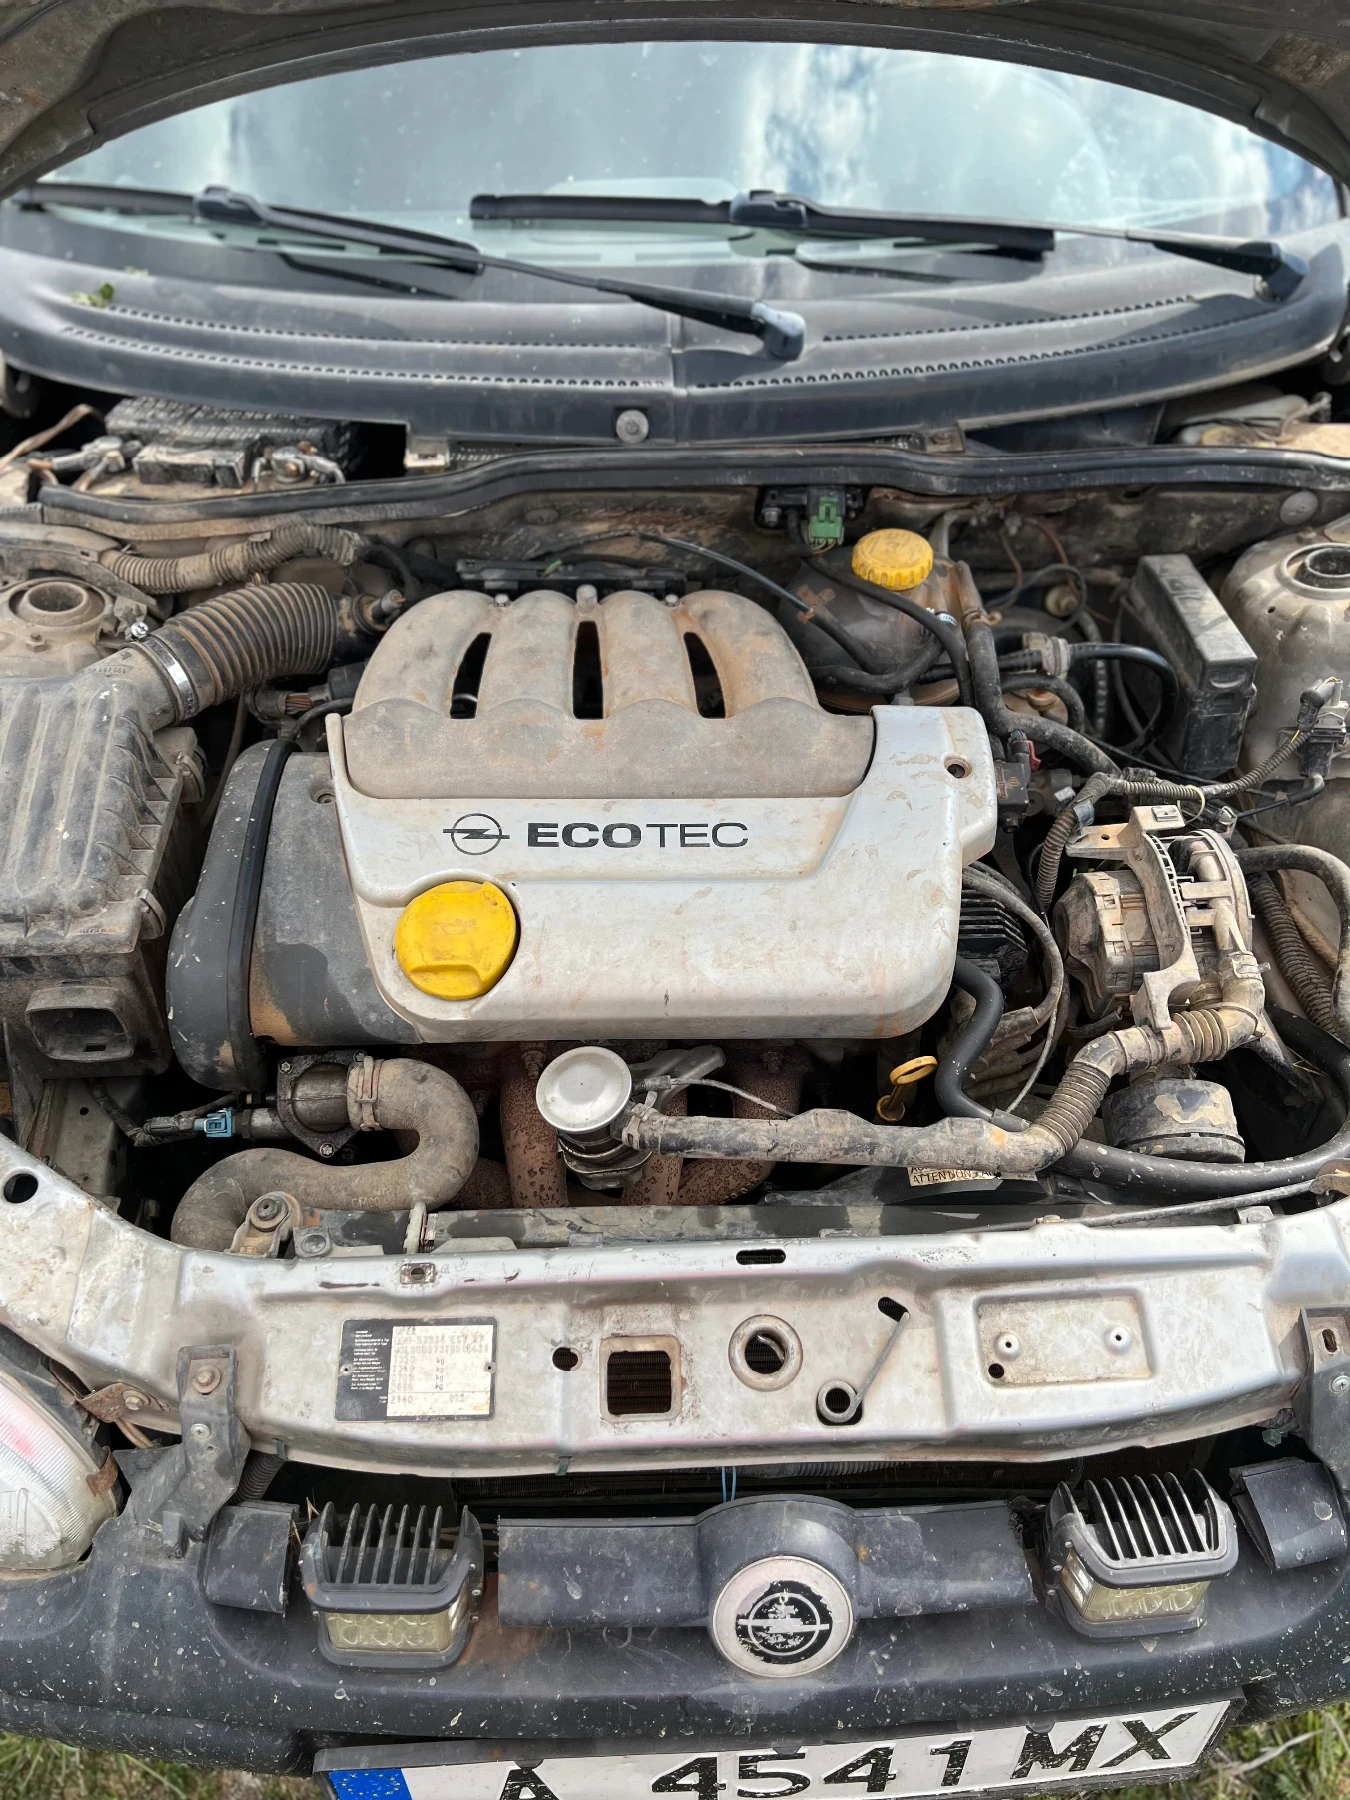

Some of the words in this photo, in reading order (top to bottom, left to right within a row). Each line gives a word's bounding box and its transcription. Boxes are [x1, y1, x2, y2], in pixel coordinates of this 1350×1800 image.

[527, 822, 749, 849] ECOTEC
[499, 1769, 560, 1800] A
[1010, 1711, 1199, 1779] MX
